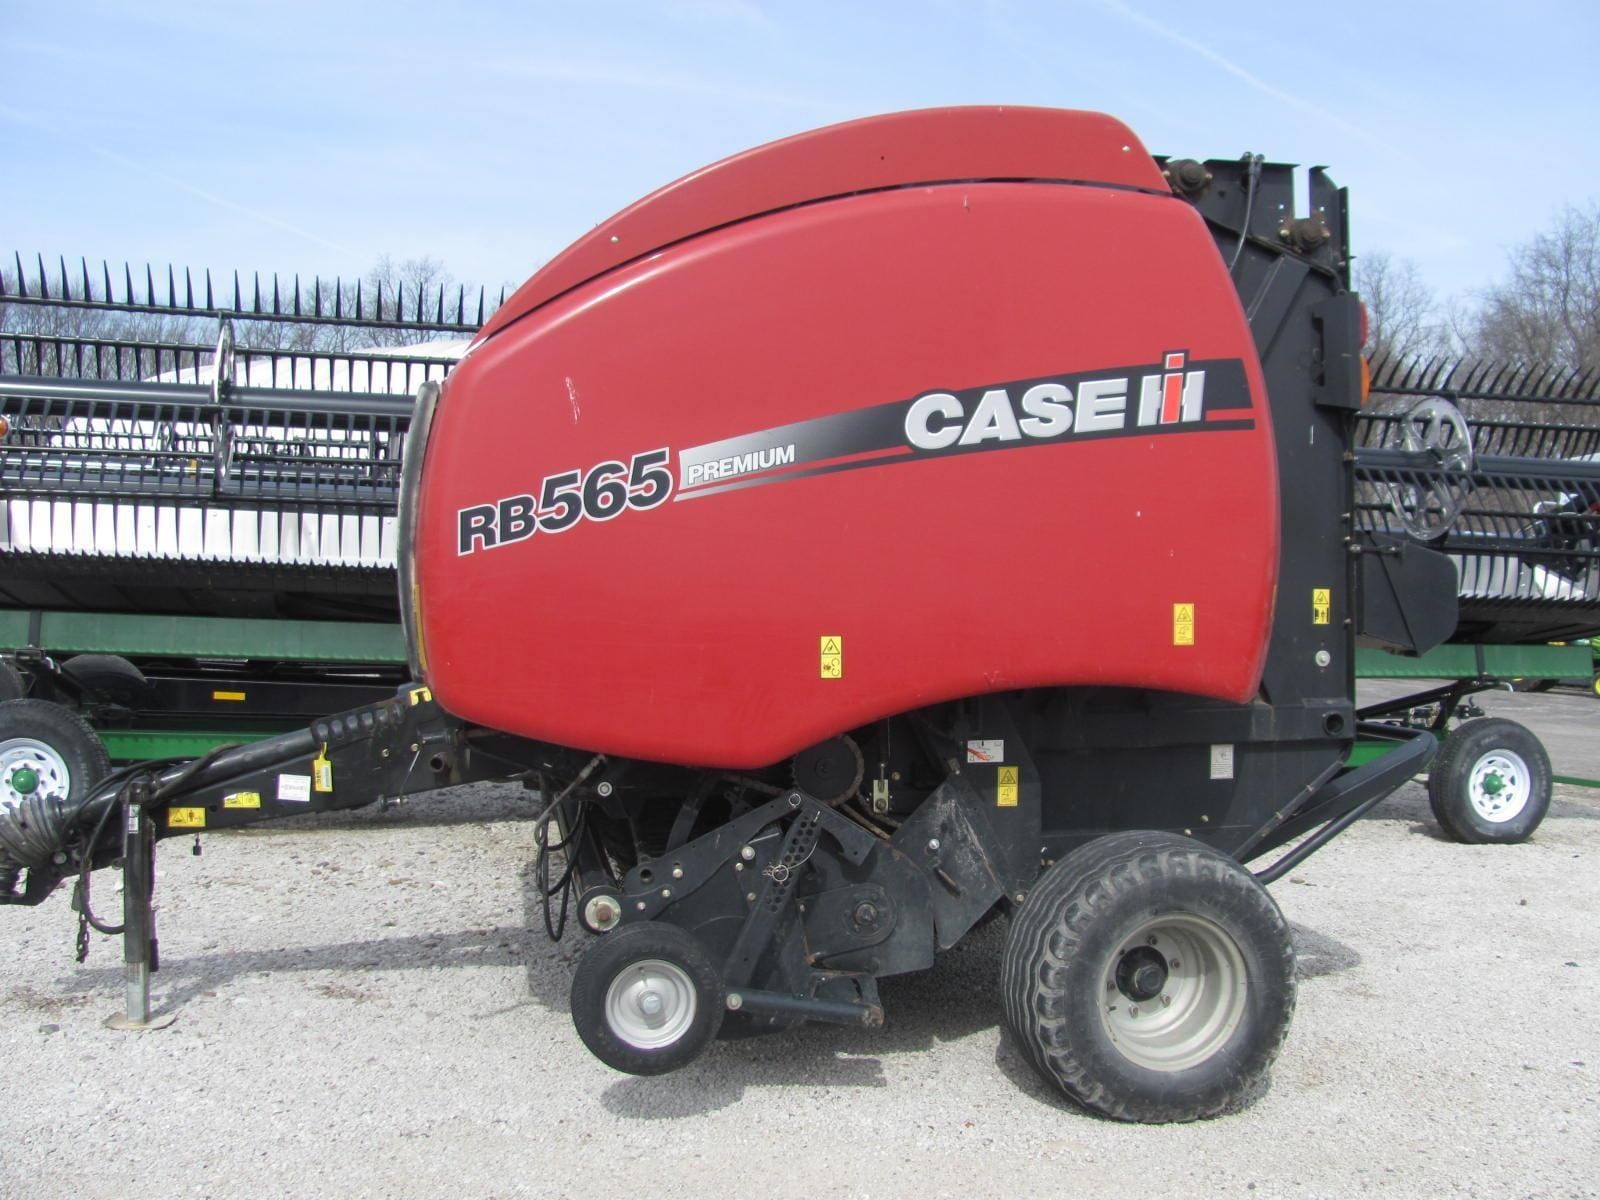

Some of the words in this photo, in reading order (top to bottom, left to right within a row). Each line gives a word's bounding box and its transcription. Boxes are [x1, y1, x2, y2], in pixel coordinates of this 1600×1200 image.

[904, 379, 1129, 450] CASE
[457, 447, 673, 556] RB565
[687, 444, 795, 485] PREMIUM
